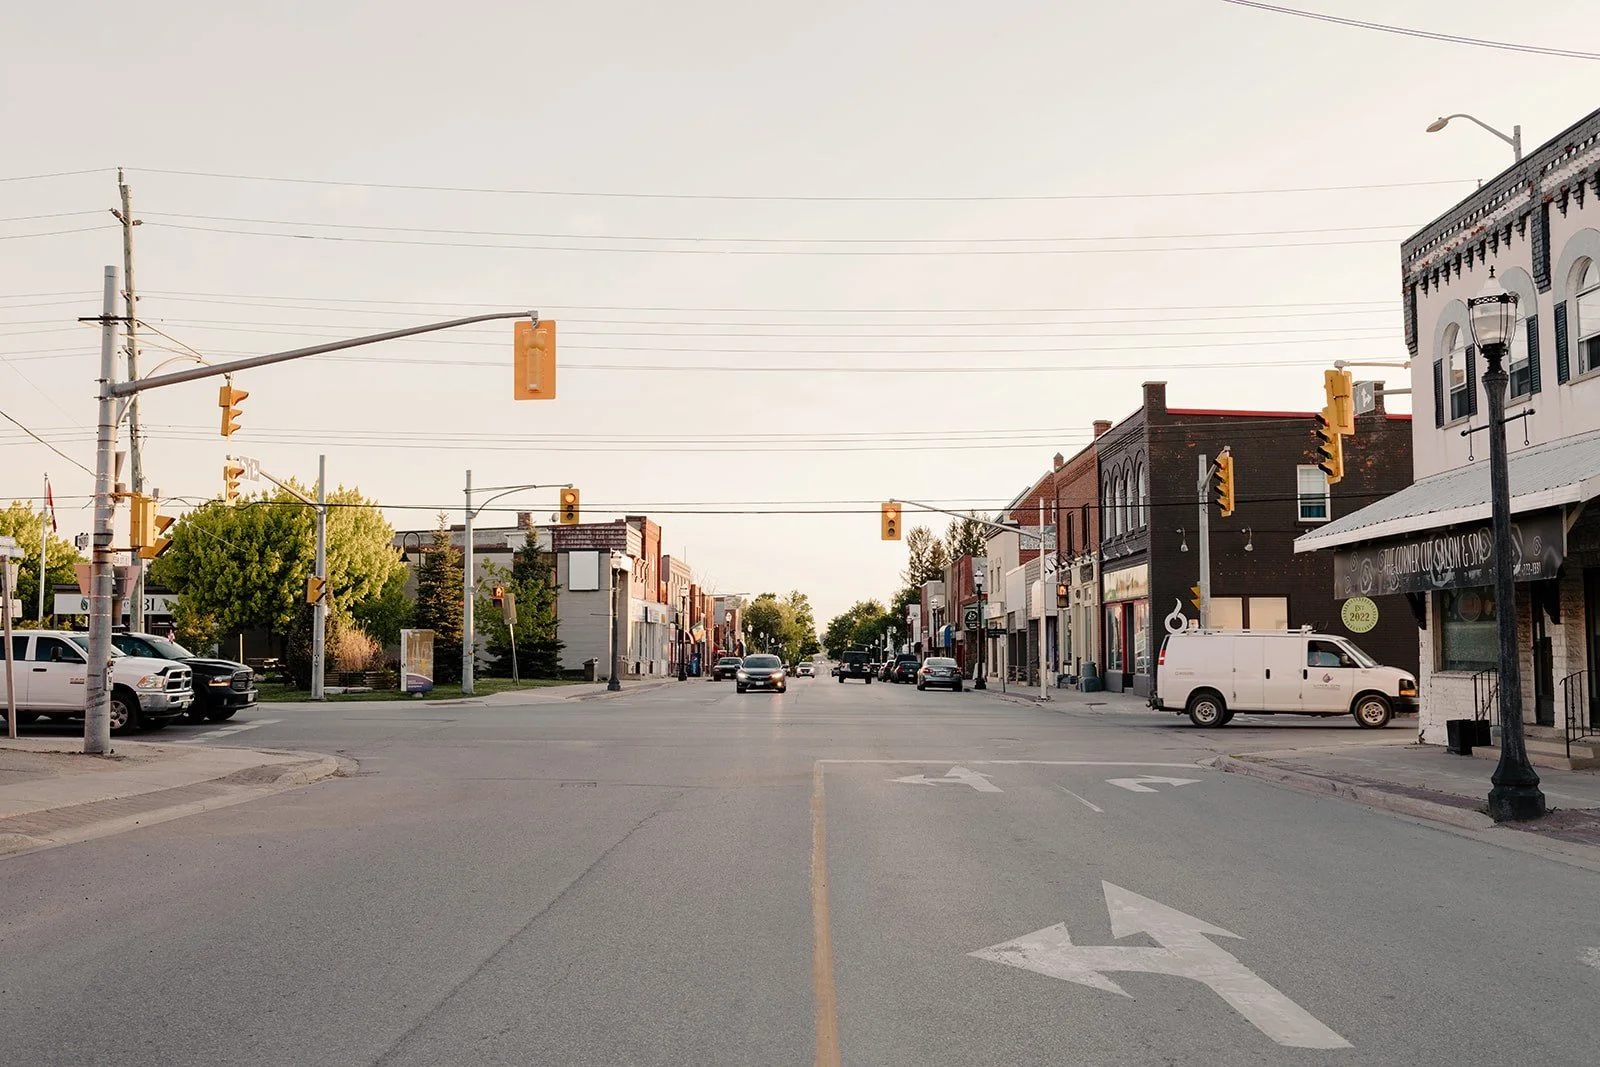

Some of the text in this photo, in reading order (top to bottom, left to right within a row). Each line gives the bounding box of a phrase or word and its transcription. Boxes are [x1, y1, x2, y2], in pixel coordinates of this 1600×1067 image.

[1395, 543, 1420, 574] CORNER
[1421, 540, 1433, 572] CUT
[1434, 535, 1461, 570] SALON
[1468, 531, 1486, 566] SPA
[1354, 604, 1365, 612] EST
[1349, 612, 1370, 622] 2022
